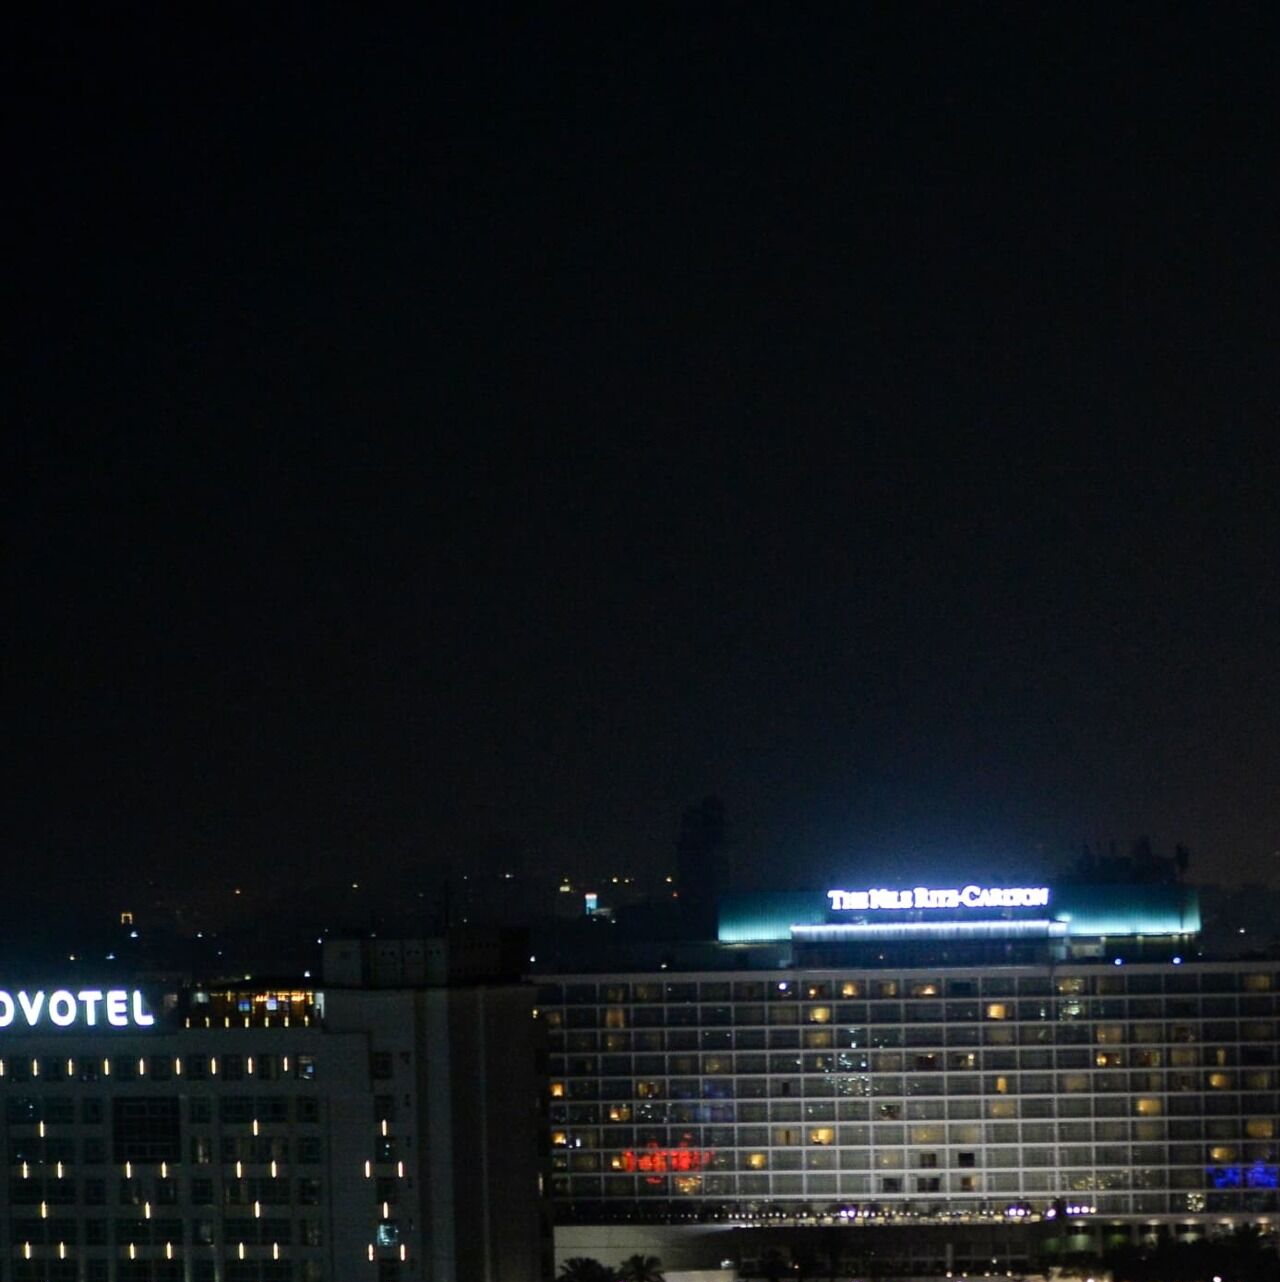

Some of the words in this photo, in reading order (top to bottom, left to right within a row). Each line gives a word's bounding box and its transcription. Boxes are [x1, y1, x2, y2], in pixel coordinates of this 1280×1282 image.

[827, 889, 869, 910] THE
[869, 888, 912, 909] NILE
[913, 885, 1050, 908] RITZ-CARLTON
